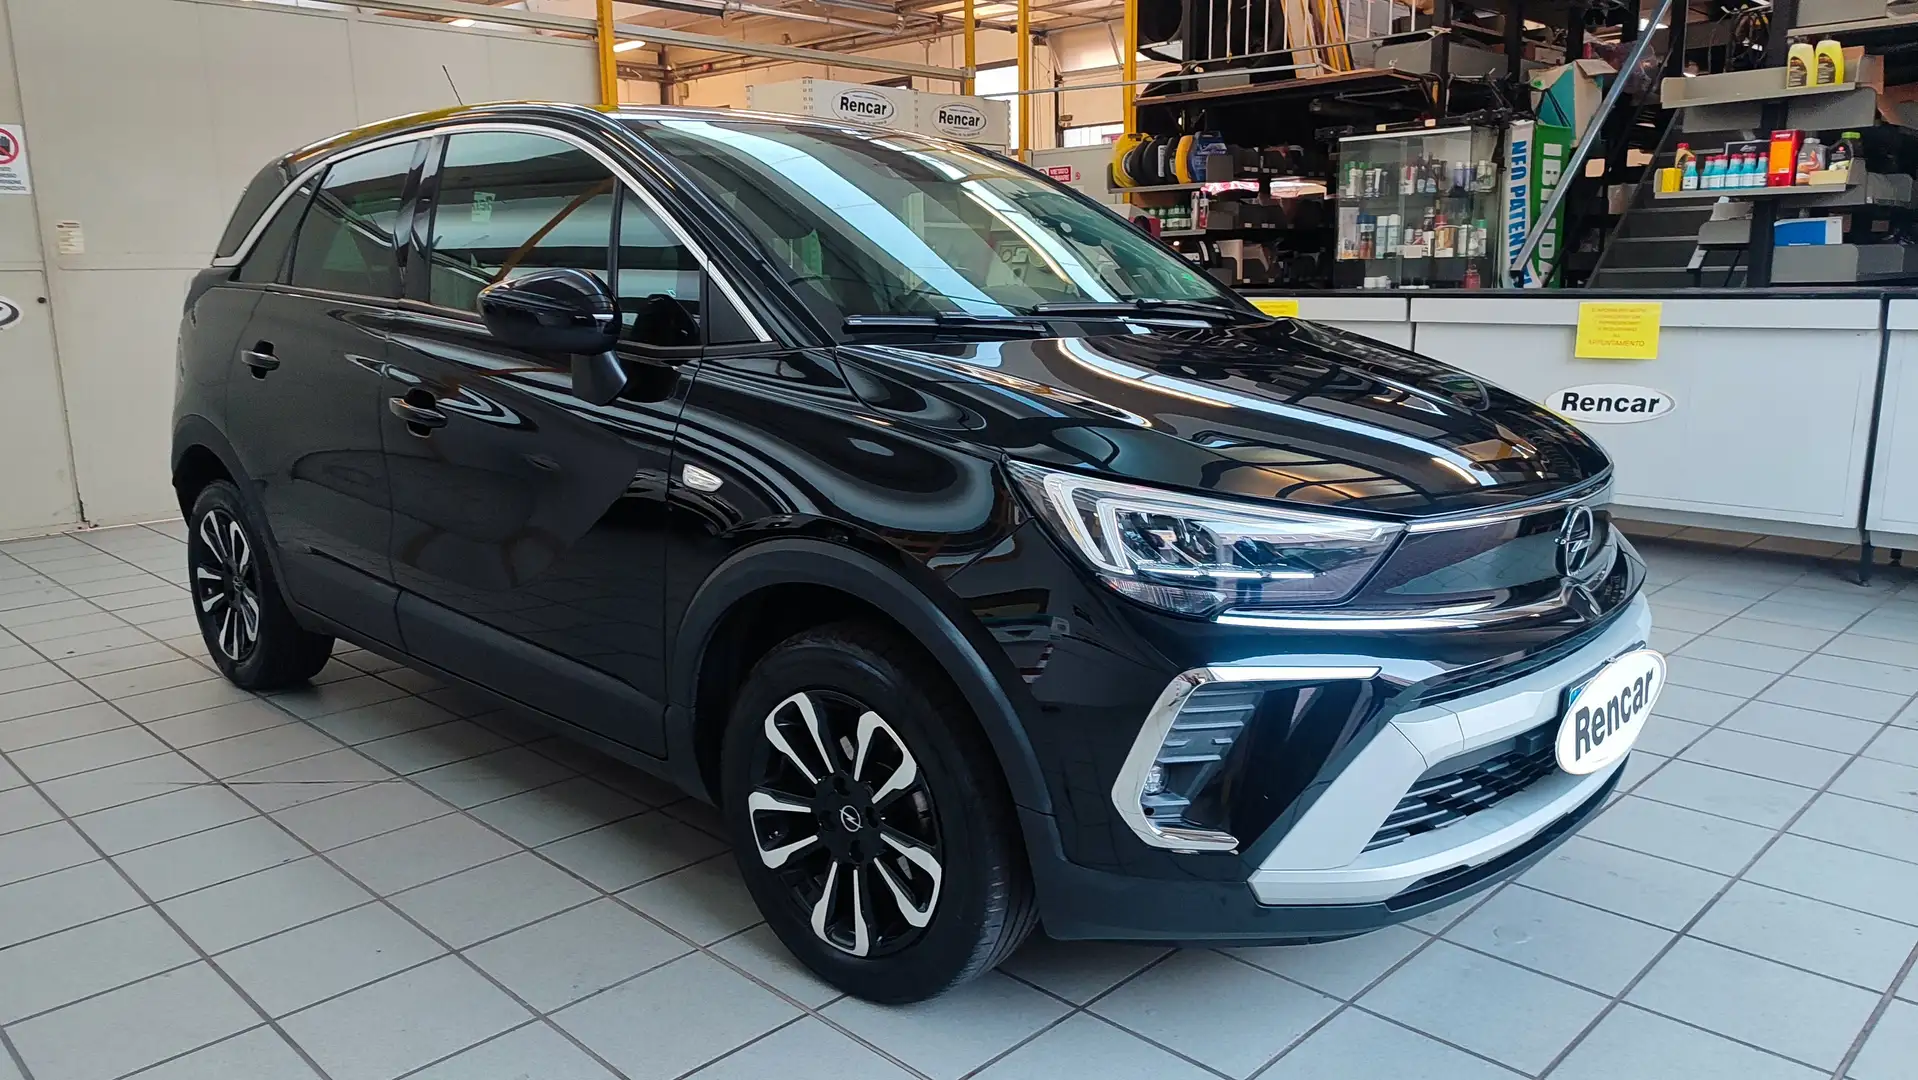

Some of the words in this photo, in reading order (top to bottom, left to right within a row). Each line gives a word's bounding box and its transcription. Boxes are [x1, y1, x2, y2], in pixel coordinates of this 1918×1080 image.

[840, 96, 887, 115] Rencar
[938, 110, 980, 127] Rencar
[1561, 392, 1660, 413] Rencar
[1575, 667, 1654, 762] Rencar
